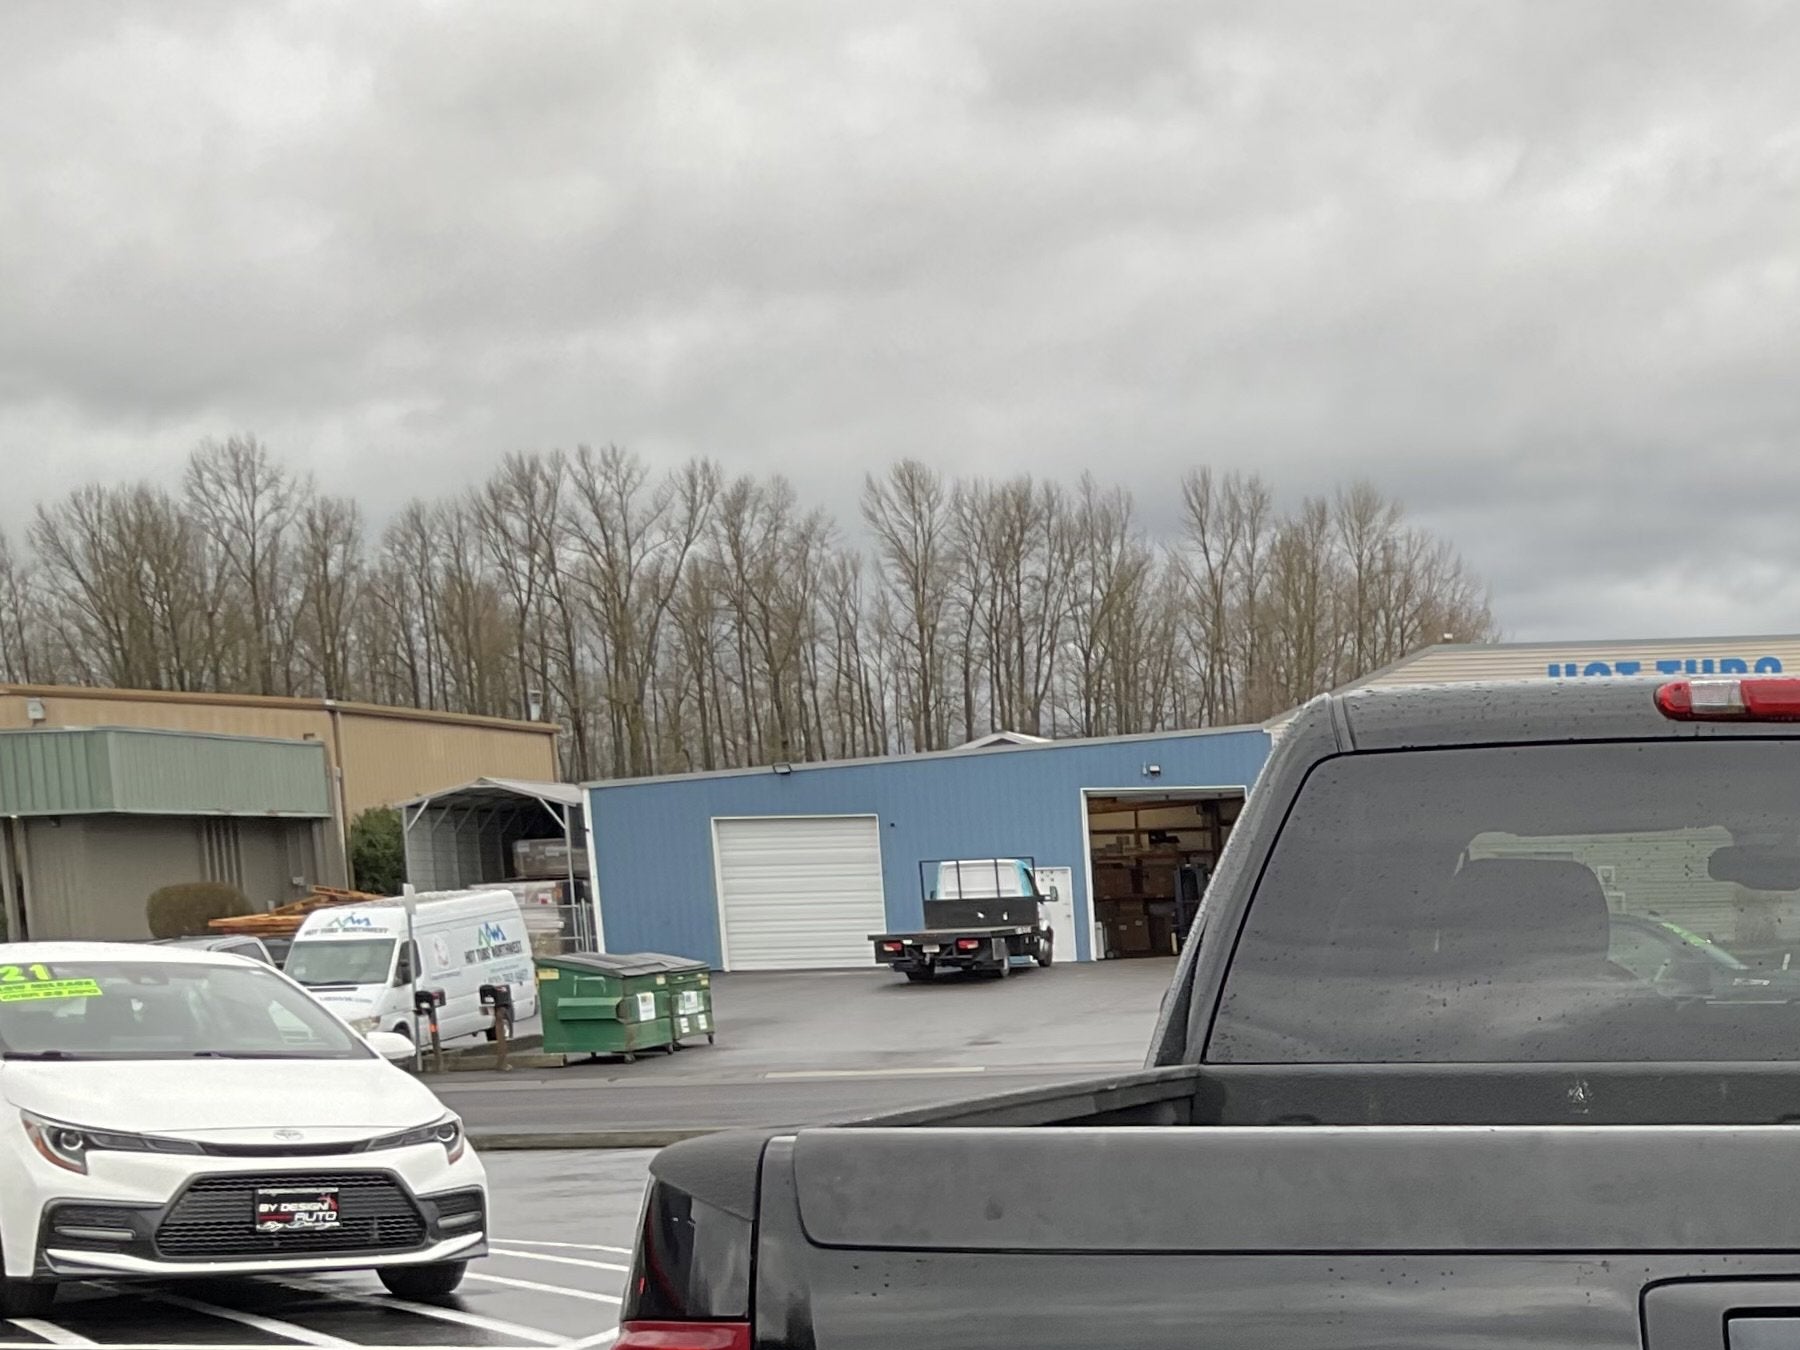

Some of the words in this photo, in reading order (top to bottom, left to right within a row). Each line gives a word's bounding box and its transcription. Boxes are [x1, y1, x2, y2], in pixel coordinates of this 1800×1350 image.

[259, 1203, 278, 1212] BY
[280, 1202, 329, 1211] DESIGN
[294, 1211, 337, 1222] AUTO
